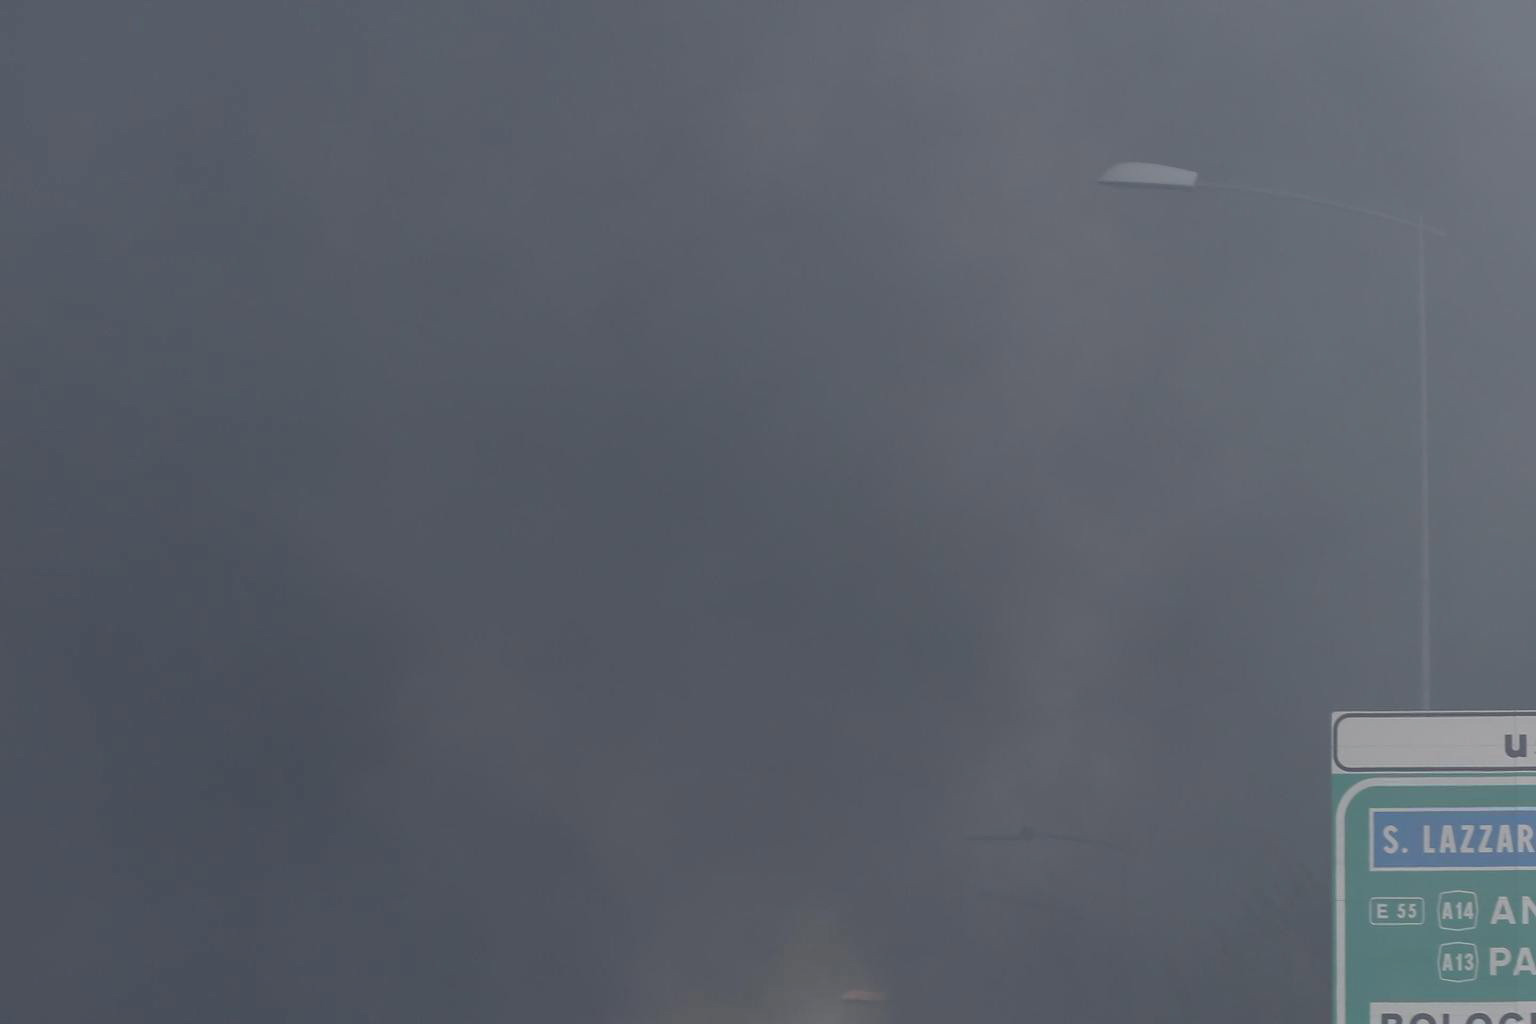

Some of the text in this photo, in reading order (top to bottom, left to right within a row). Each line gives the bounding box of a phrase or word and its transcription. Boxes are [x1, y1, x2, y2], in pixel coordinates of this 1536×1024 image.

[1383, 825, 1408, 854] S.
[1377, 904, 1388, 919] E
[1397, 904, 1418, 919] 55
[1442, 901, 1474, 921] A14
[1442, 953, 1475, 972] A13
